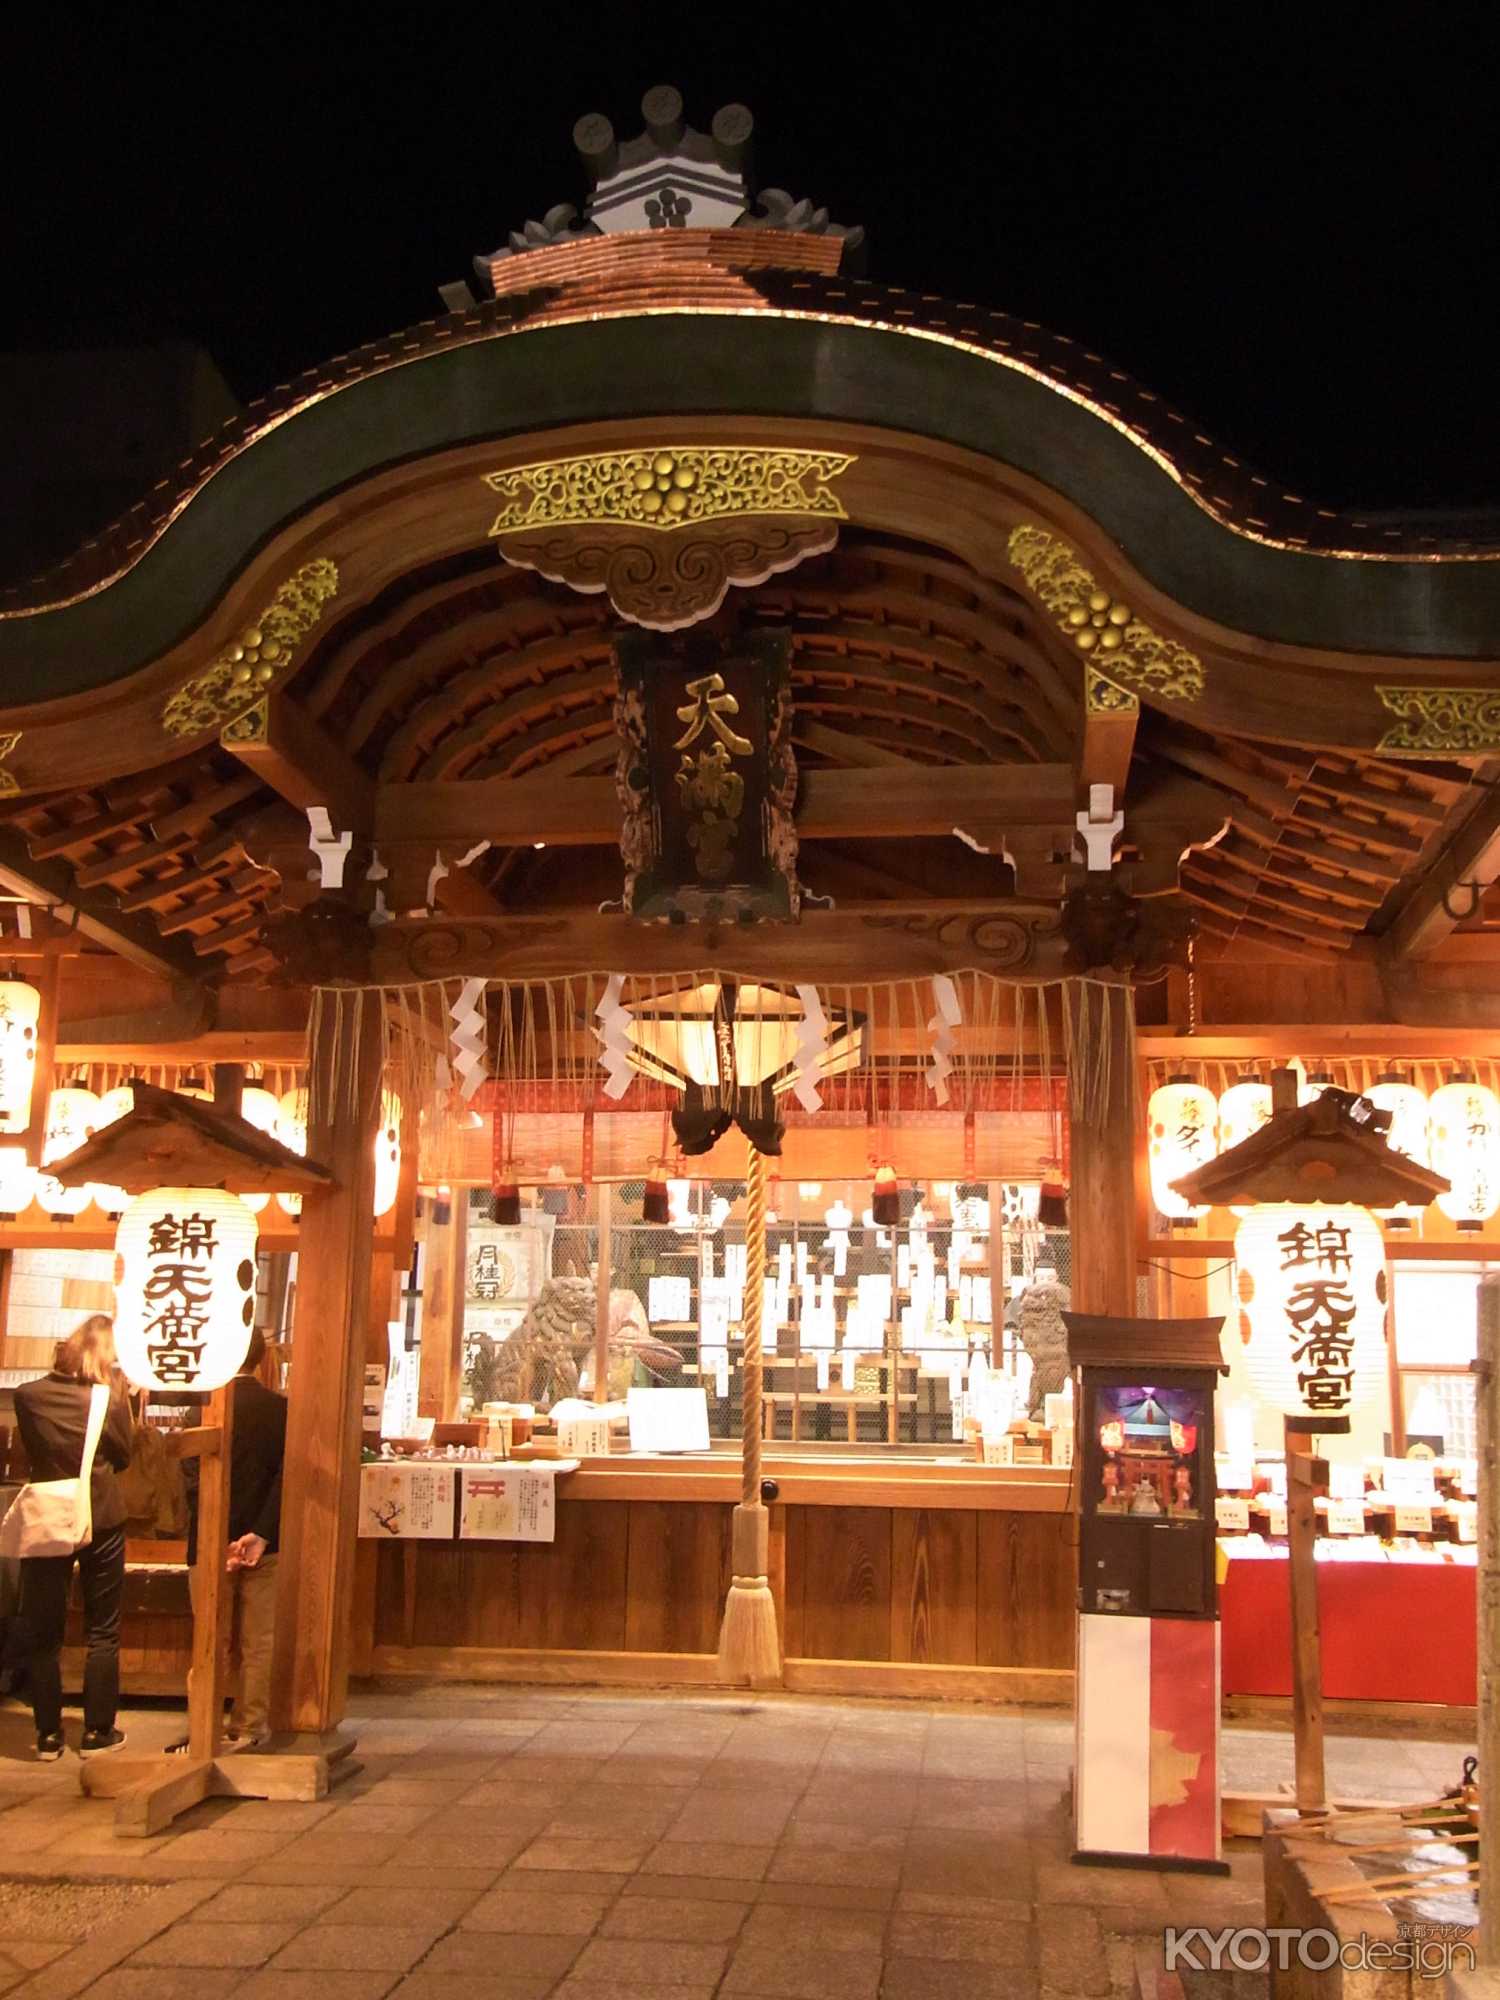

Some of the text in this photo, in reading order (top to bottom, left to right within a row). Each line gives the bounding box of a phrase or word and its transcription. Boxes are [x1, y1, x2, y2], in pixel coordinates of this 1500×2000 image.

[142, 1213, 220, 1384] 錦天満宮
[474, 1244, 501, 1300] 月桂冠
[1277, 1221, 1357, 1410] 錦天満宮
